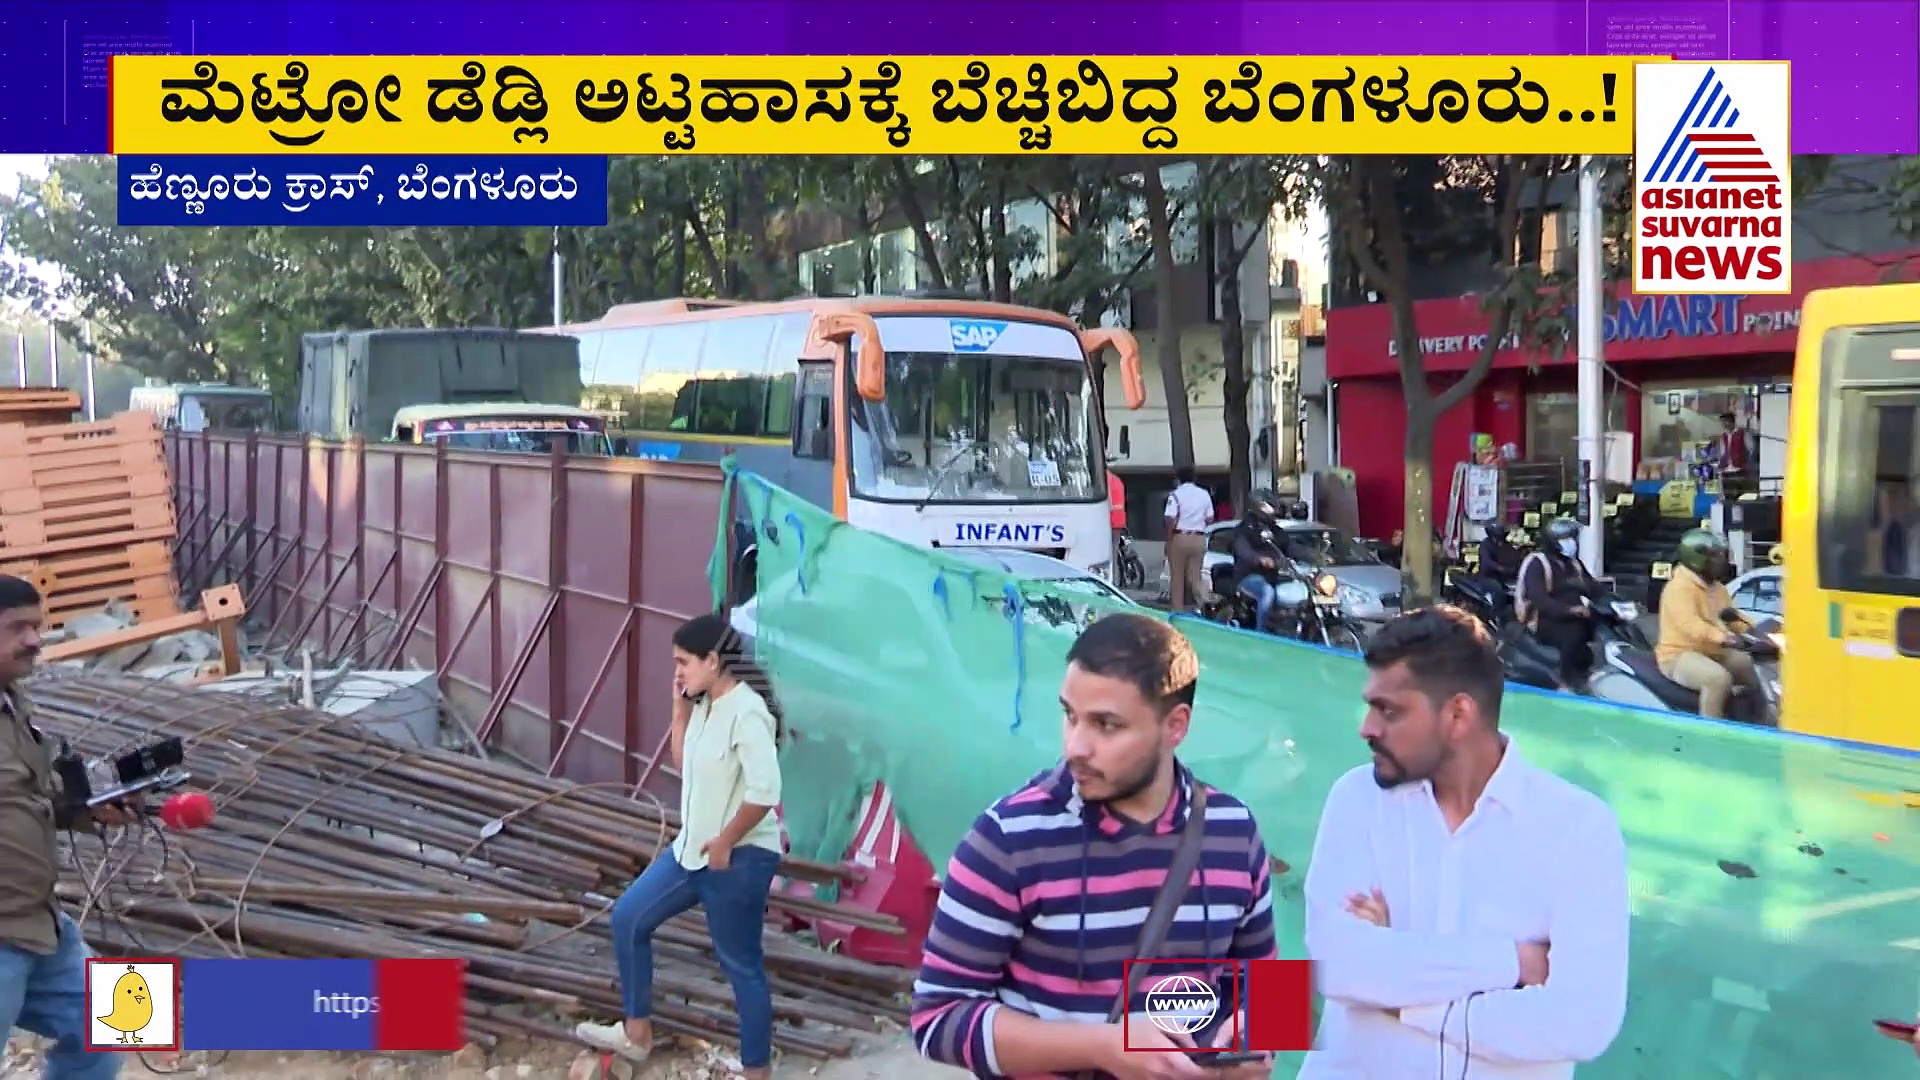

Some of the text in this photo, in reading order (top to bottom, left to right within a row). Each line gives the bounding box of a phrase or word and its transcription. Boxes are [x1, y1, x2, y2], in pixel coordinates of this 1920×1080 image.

[951, 325, 998, 347] SAP
[1388, 335, 1464, 356] DIVERY
[955, 523, 1065, 542] INFANT'S
